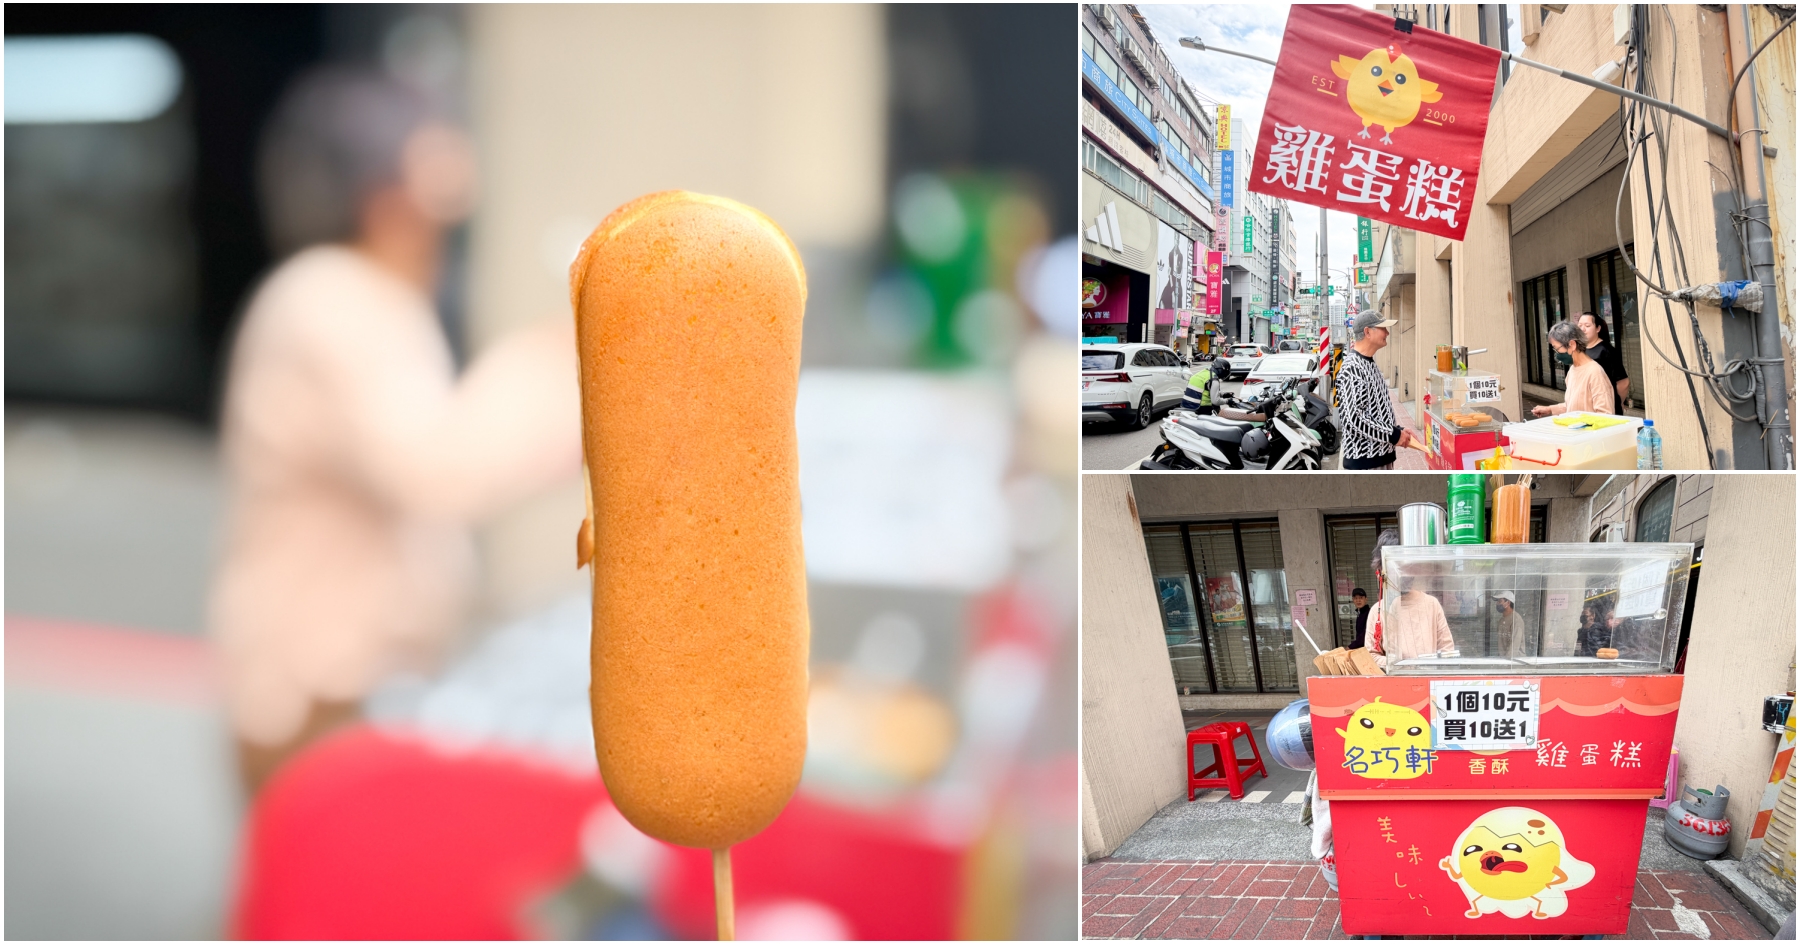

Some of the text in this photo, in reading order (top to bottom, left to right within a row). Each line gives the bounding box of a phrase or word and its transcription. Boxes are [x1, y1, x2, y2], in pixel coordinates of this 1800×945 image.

[1311, 76, 1335, 90] EST
[1425, 108, 1456, 124] 2000
[1223, 165, 1232, 198] 城市商旅
[1262, 122, 1465, 229] 雞蛋糕
[1360, 220, 1369, 236] 銀行
[1186, 242, 1194, 309] SUPERSTAR
[1469, 380, 1497, 390] 1個10元
[1469, 390, 1497, 400] 買10送1
[1444, 690, 1530, 713] 1個10元
[1443, 718, 1527, 741] 買10送1
[1341, 745, 1438, 774] 名巧軒
[1468, 738, 1643, 775] 香酥 雞蛋糕
